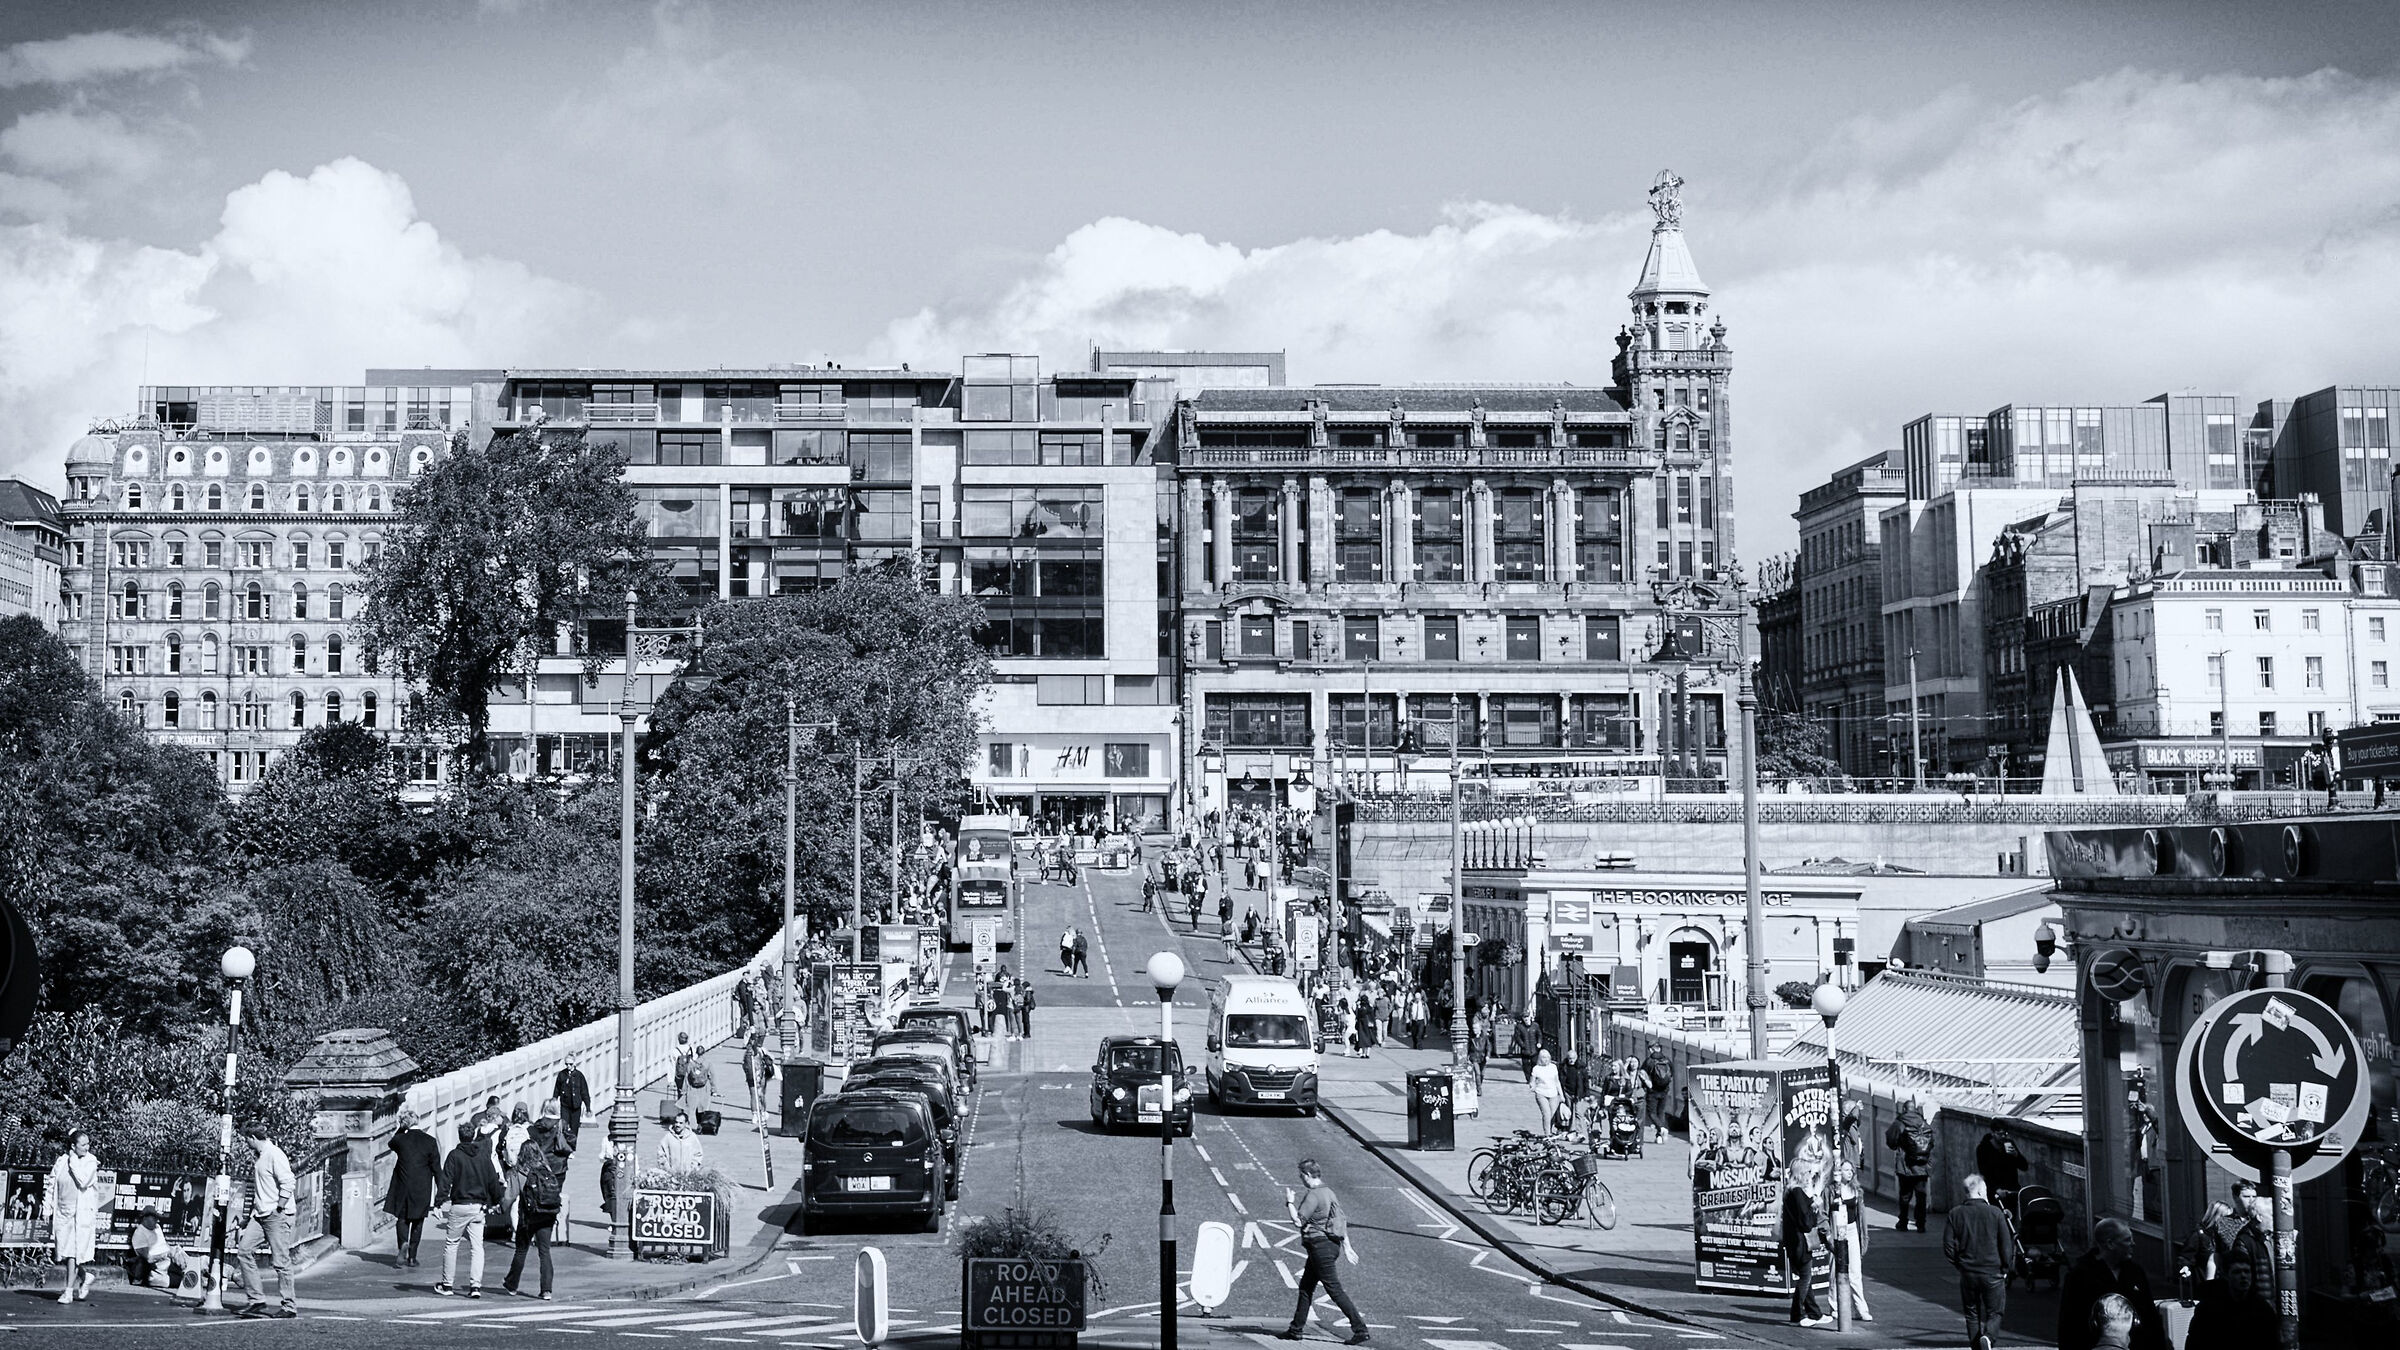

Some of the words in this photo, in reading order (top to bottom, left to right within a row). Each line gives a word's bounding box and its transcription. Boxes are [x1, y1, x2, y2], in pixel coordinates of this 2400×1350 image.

[2147, 748, 2180, 764] BLACK
[2184, 748, 2216, 764] SHEEP
[2218, 748, 2257, 765] CFFEE
[1593, 891, 1626, 905] THE
[1631, 891, 1717, 906] BOOKING
[1722, 892, 1792, 907] OFICE
[837, 972, 863, 981] MAIC
[1720, 1075, 1754, 1092] PARTY
[1755, 1077, 1770, 1093] OF
[1702, 1090, 1724, 1105] THE
[1799, 1112, 1828, 1128] SOLO
[653, 1194, 696, 1210] ROAD
[1700, 1188, 1750, 1208] GREATEST
[646, 1206, 701, 1225] AHEAD
[641, 1222, 705, 1239] CLOSED
[998, 1264, 1059, 1282] ROAD
[990, 1285, 1066, 1303] AHEAD
[983, 1306, 1072, 1325] CLOSED
